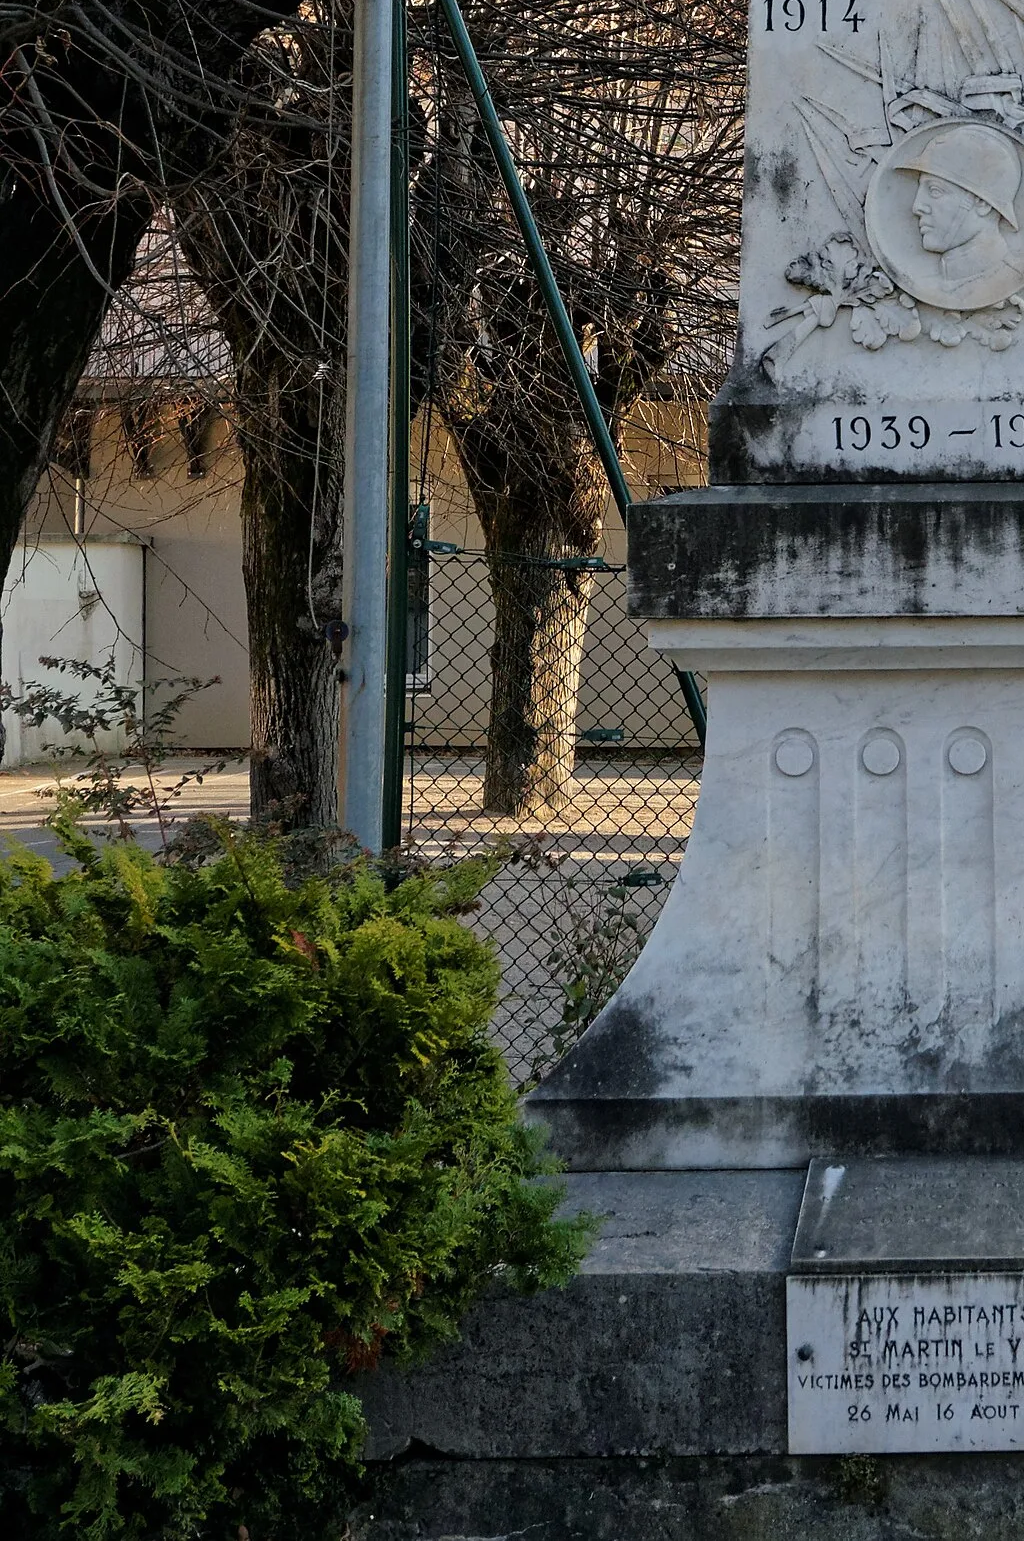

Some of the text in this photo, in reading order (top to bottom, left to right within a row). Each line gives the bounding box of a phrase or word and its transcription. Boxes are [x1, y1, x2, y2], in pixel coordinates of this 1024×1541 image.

[832, 414, 931, 451] 1939
[859, 1306, 899, 1325] AUX
[883, 1339, 962, 1357] MARTIN
[975, 1342, 995, 1356] LE
[798, 1374, 874, 1390] VICTIMES
[882, 1373, 911, 1389] DES
[847, 1405, 872, 1423] 26
[936, 1403, 954, 1420] 16
